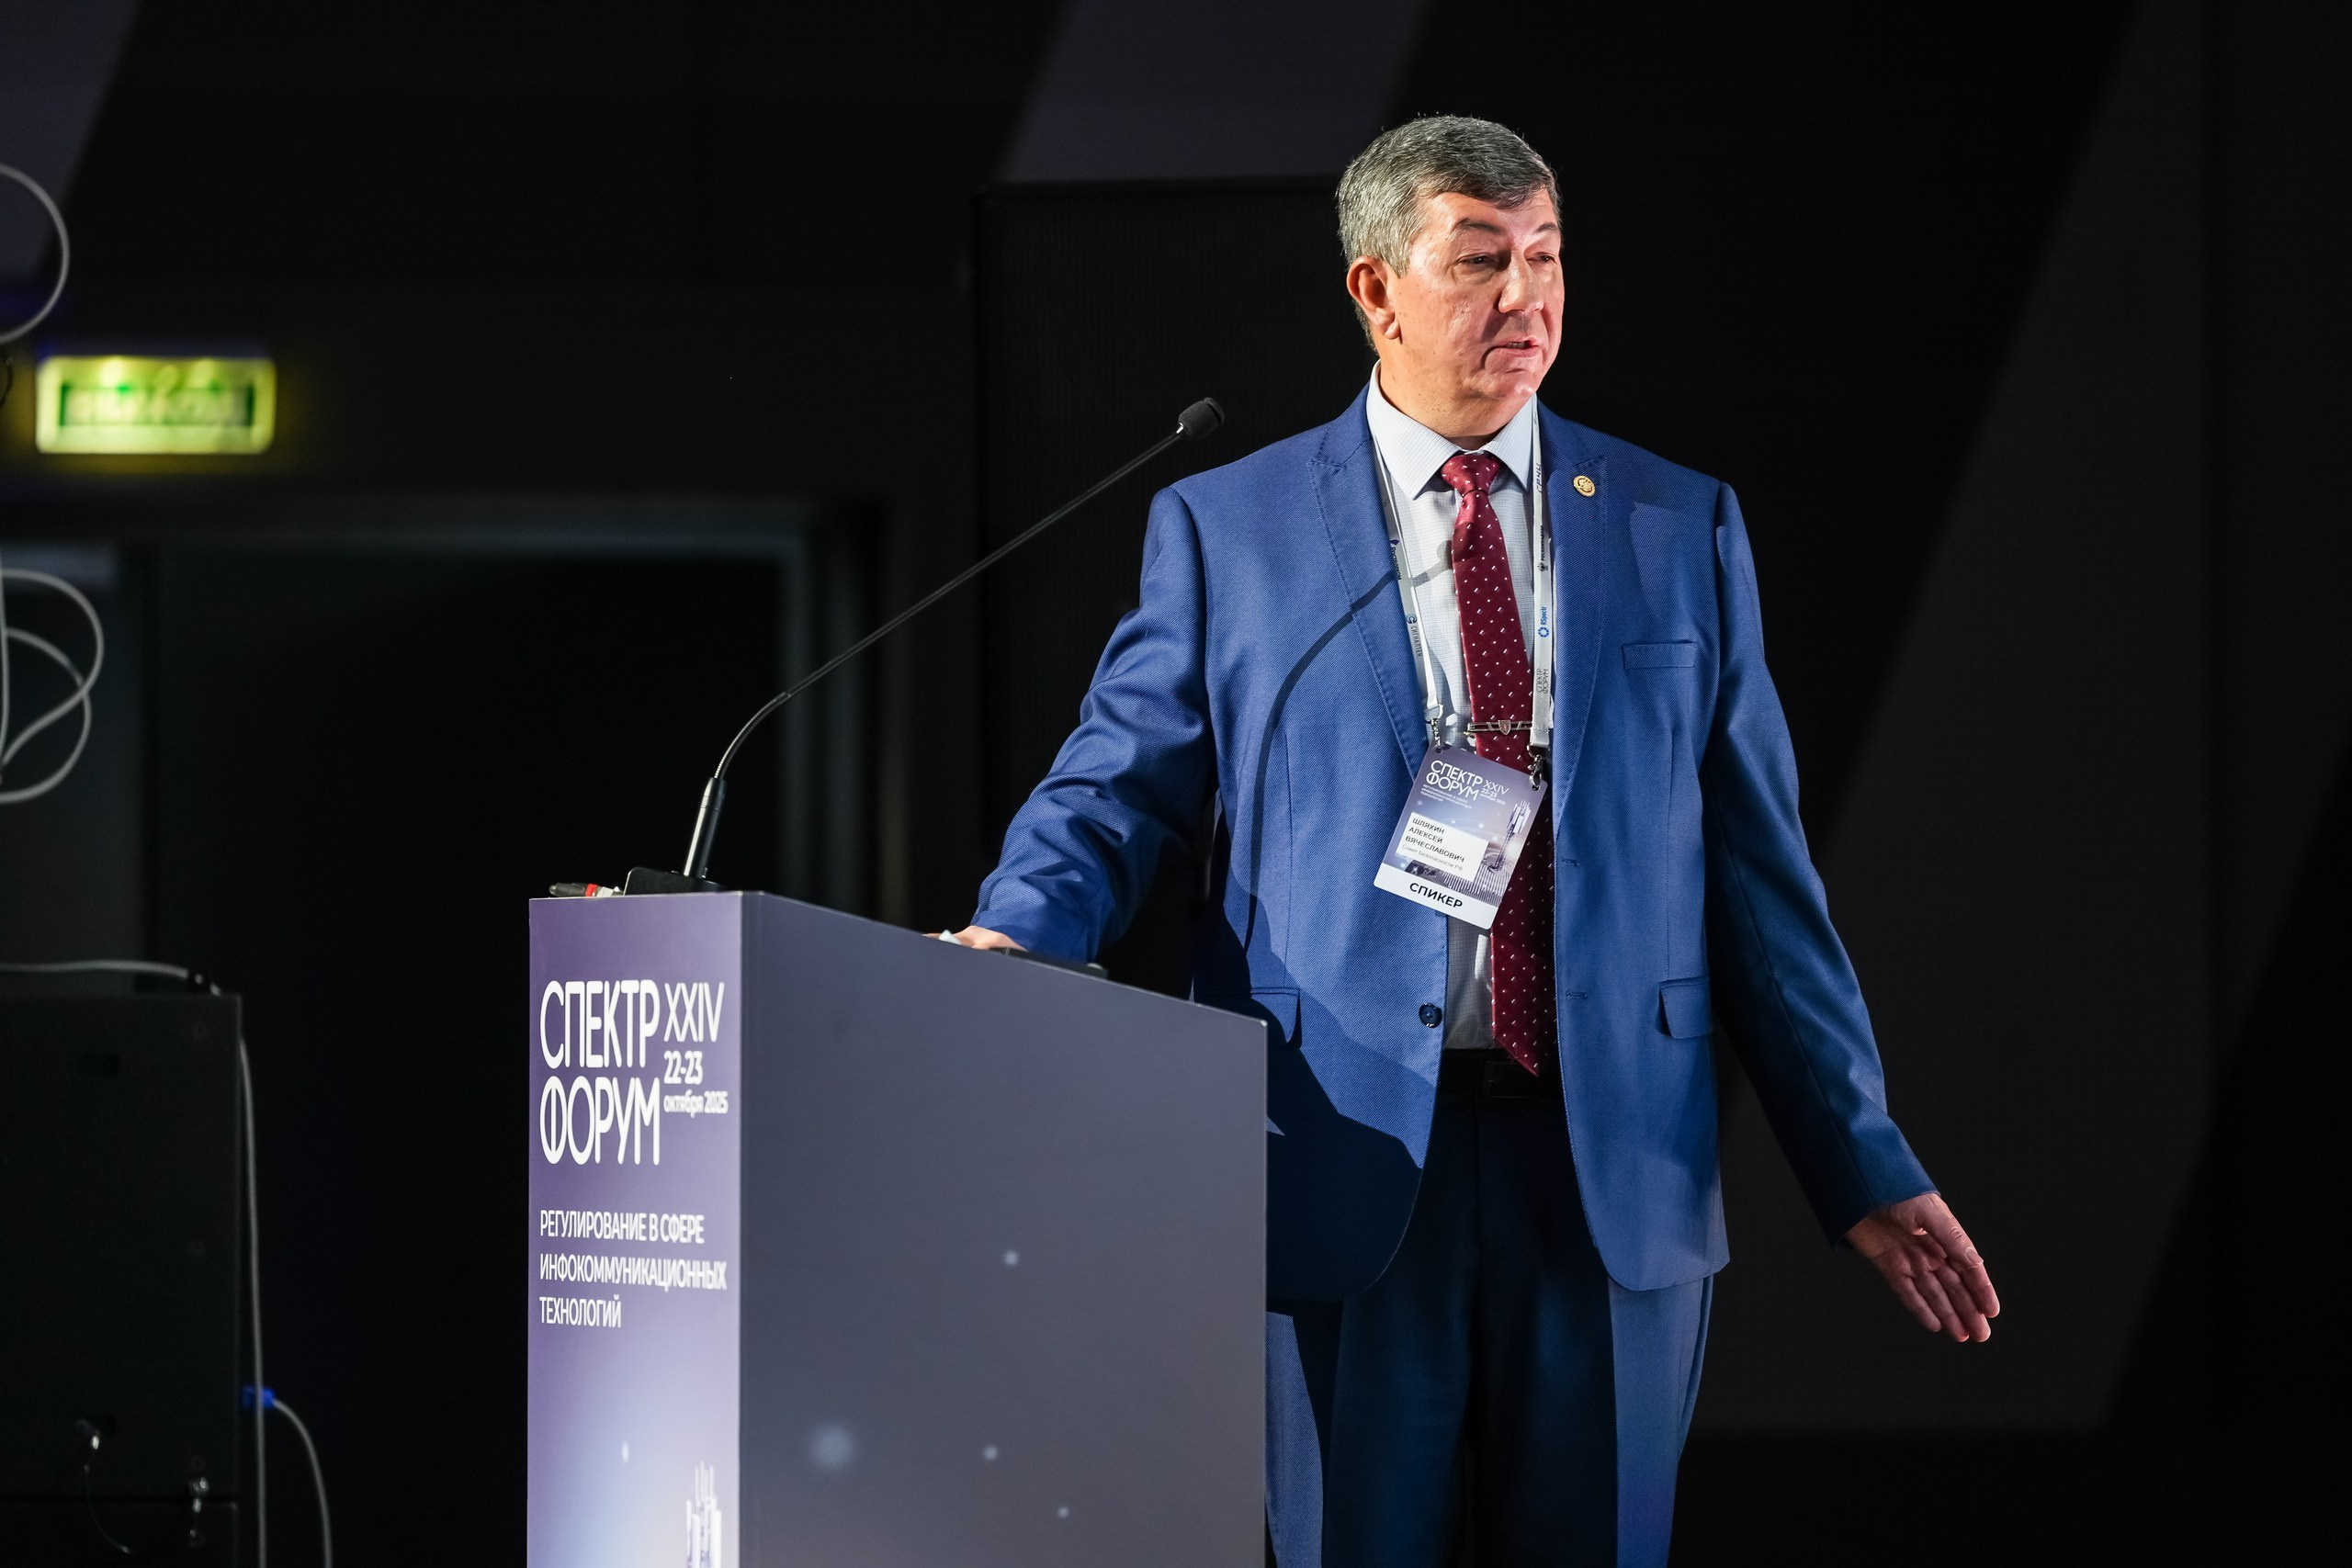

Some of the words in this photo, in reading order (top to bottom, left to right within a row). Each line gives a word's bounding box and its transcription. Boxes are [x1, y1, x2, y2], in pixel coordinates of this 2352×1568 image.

[1426, 772, 1480, 802] ФОРУМ
[1430, 760, 1484, 787] СПЕКТР
[1484, 779, 1510, 795] XXIV
[1408, 827, 1443, 844] АЛЕКСЕЙ
[1412, 818, 1445, 835] ШЛЯХИН
[1405, 835, 1465, 863] ВЯЧЕСЛАВОВИЧ
[1409, 882, 1463, 908] СПИКЕР
[539, 978, 661, 1069] СПЕКТР
[663, 981, 725, 1043] XXIV
[663, 1050, 704, 1086] 22-23
[663, 1089, 704, 1119] октября
[704, 1090, 729, 1114] 2025
[539, 1075, 661, 1166] ФОРУМ
[540, 1209, 647, 1241] РЕГУЛИРОВАНИЕ
[649, 1213, 659, 1242] В
[660, 1213, 706, 1245] СФЕРЕ
[540, 1253, 728, 1292] ИНФОКОММУНИКАЦИОННЫХ
[539, 1293, 621, 1328] ТЕХНОЛОГИЙ
